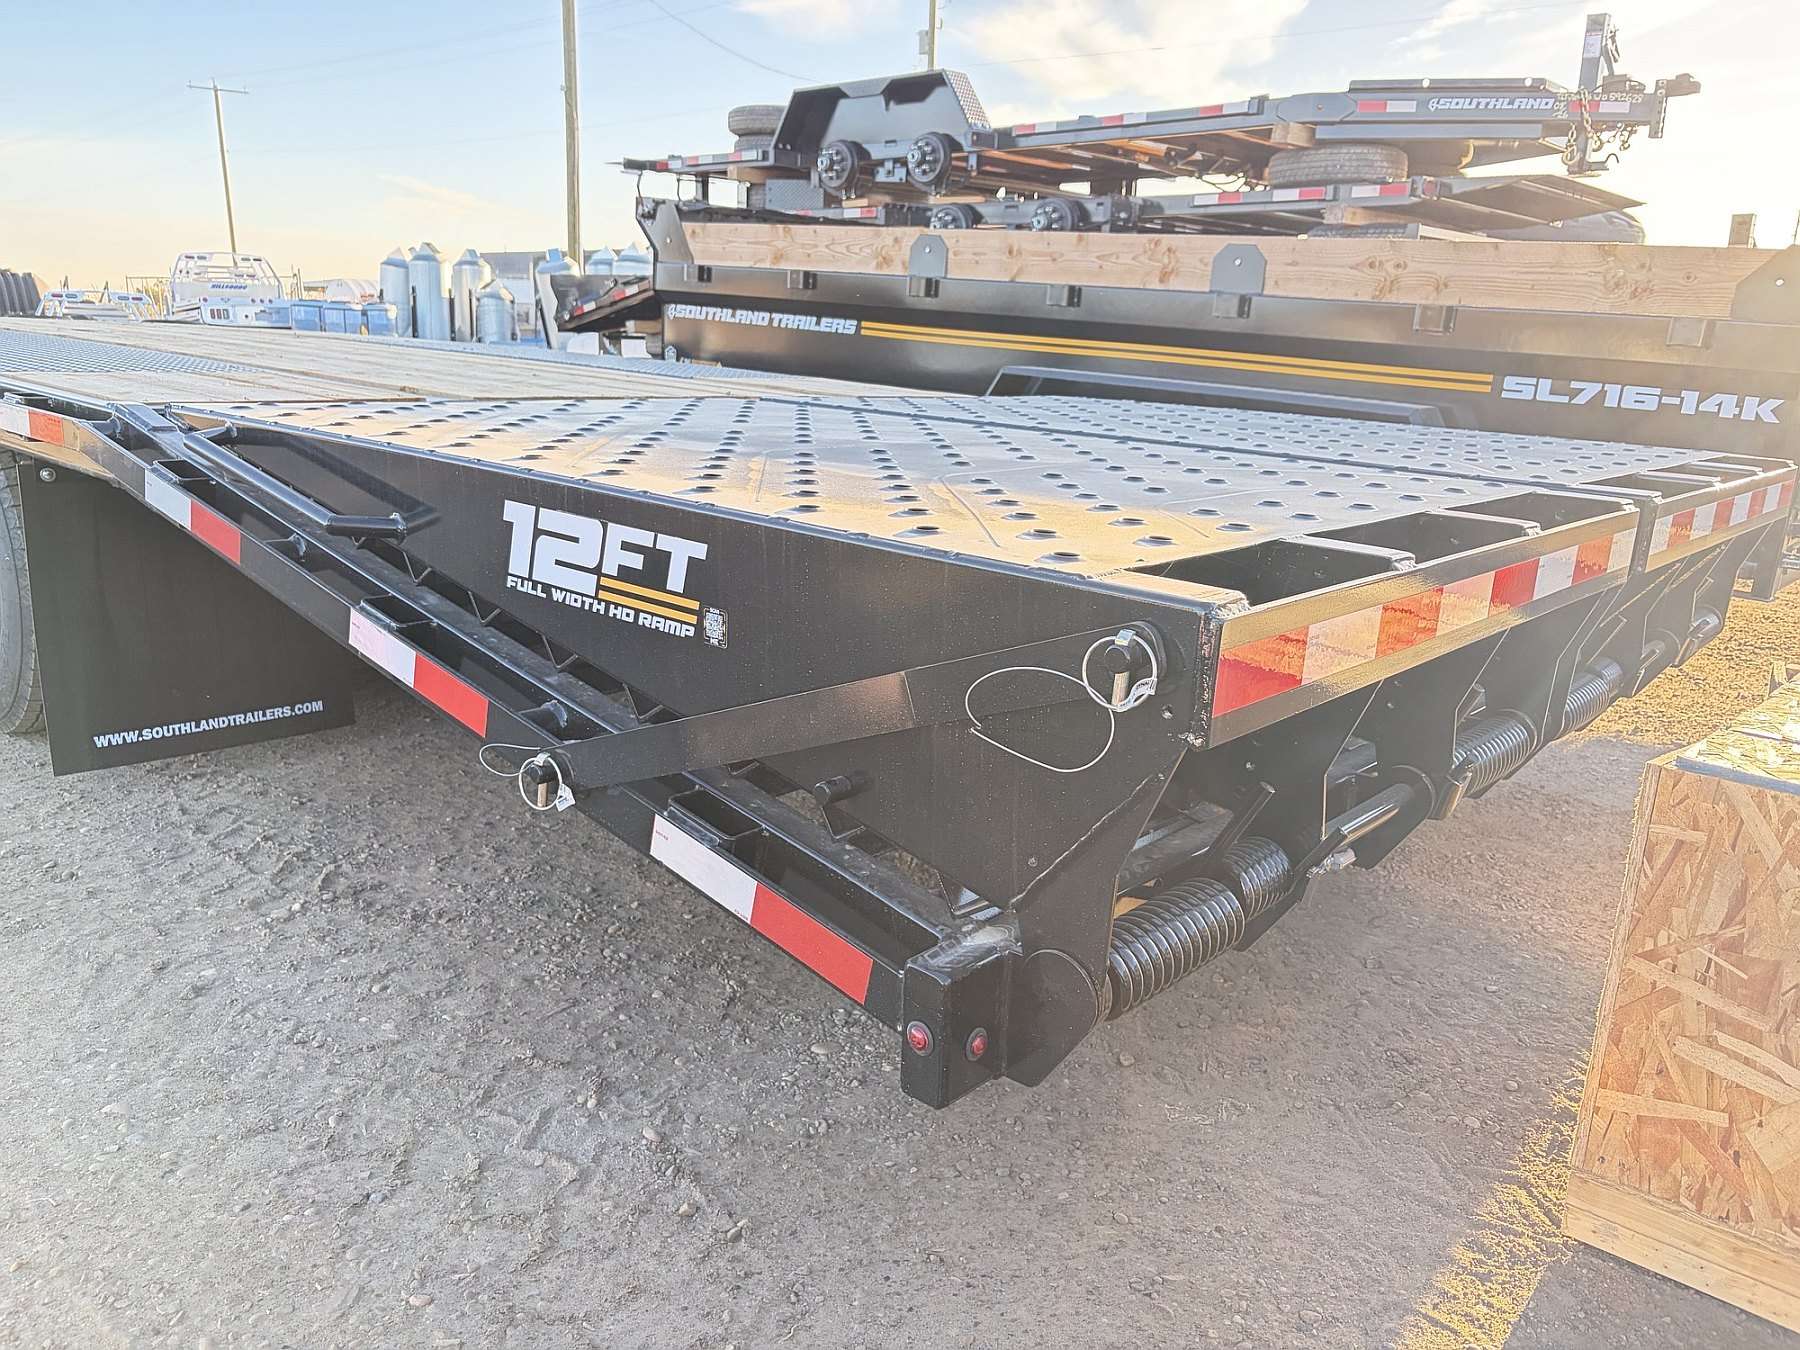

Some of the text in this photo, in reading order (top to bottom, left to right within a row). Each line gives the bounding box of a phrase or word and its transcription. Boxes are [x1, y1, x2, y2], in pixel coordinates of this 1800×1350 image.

[1438, 97, 1555, 110] SOUTHLAND
[674, 303, 858, 335] SOUTHLAND TRAILERS
[1501, 374, 1785, 424] SL716-14K
[502, 499, 709, 597] 12FT
[506, 574, 547, 599] FULL
[551, 587, 606, 616] WIDTH
[608, 603, 636, 624] HD
[638, 611, 696, 638] RAMP
[92, 699, 324, 749] WWW.SOUTHLANDTRAILERS.COM
